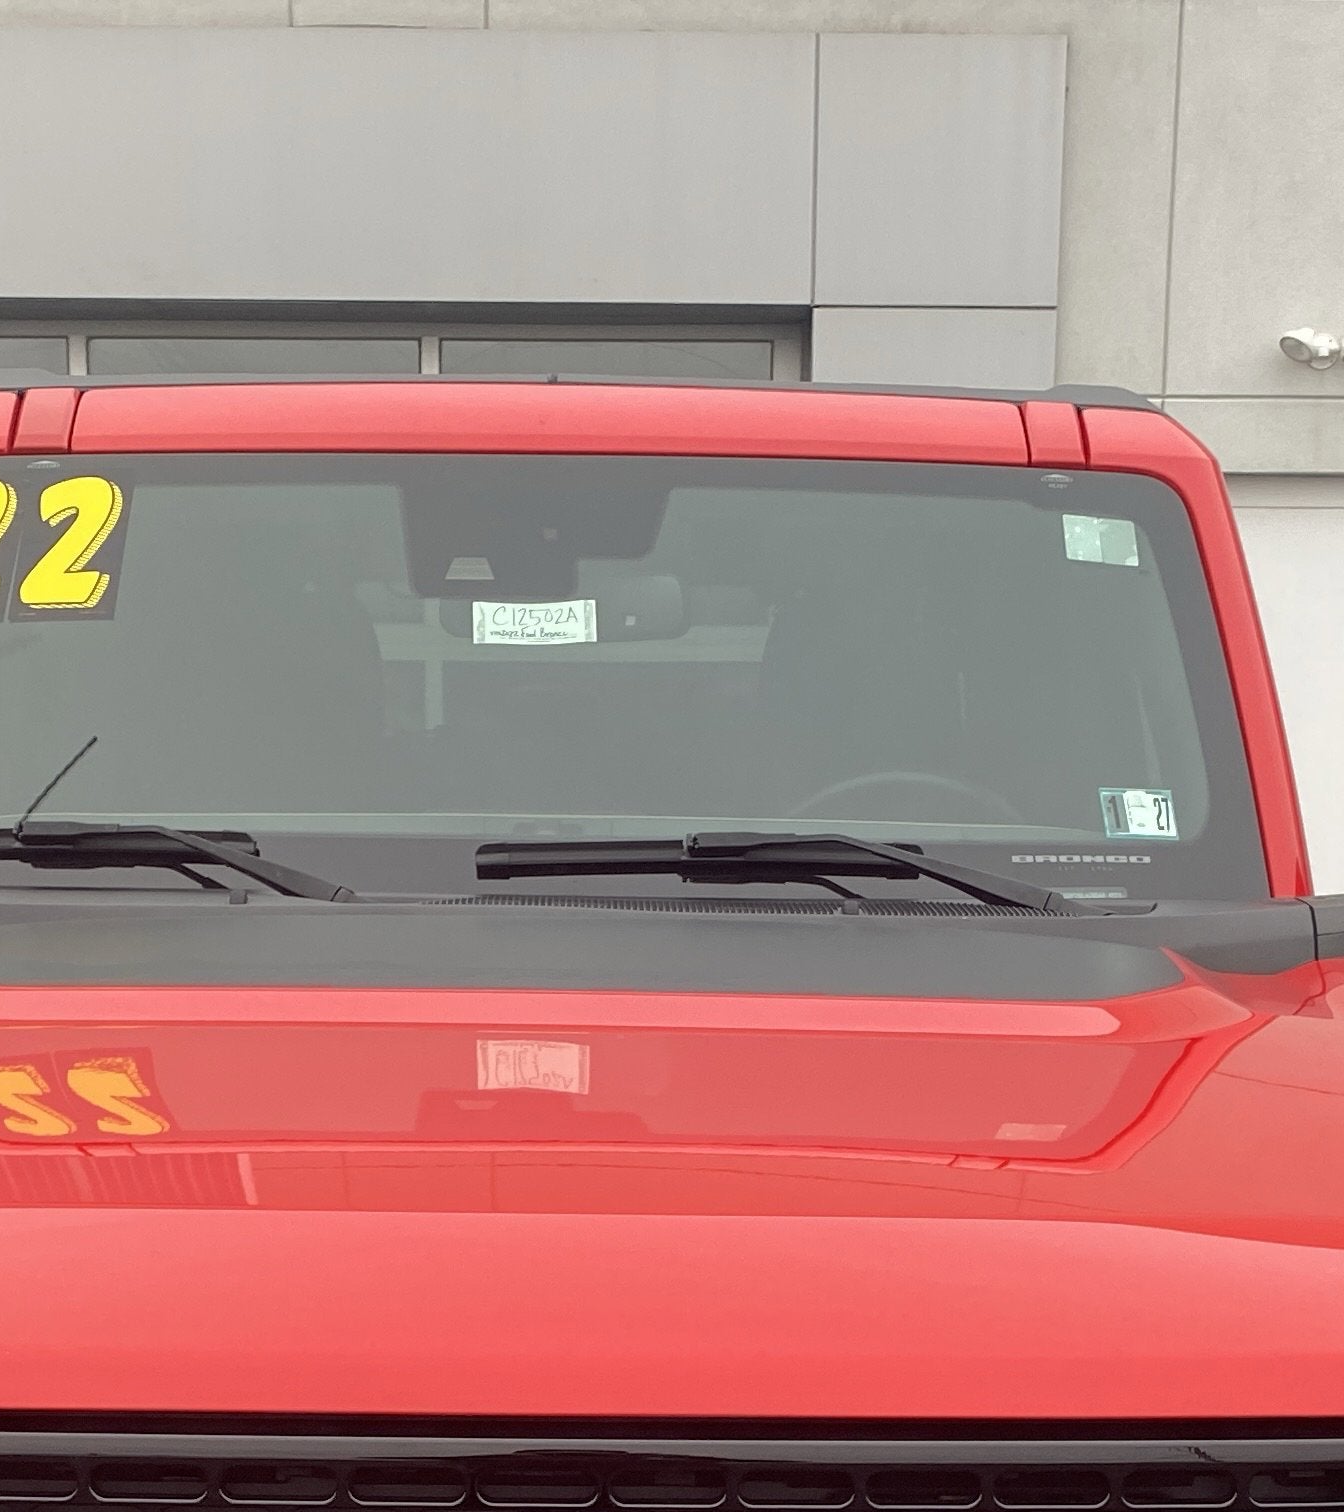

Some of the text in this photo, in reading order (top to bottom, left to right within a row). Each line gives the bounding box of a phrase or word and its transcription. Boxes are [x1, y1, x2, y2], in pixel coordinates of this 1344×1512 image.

[492, 605, 579, 626] C12502A
[1152, 796, 1171, 833] 27
[1011, 855, 1151, 863] BRONCO
